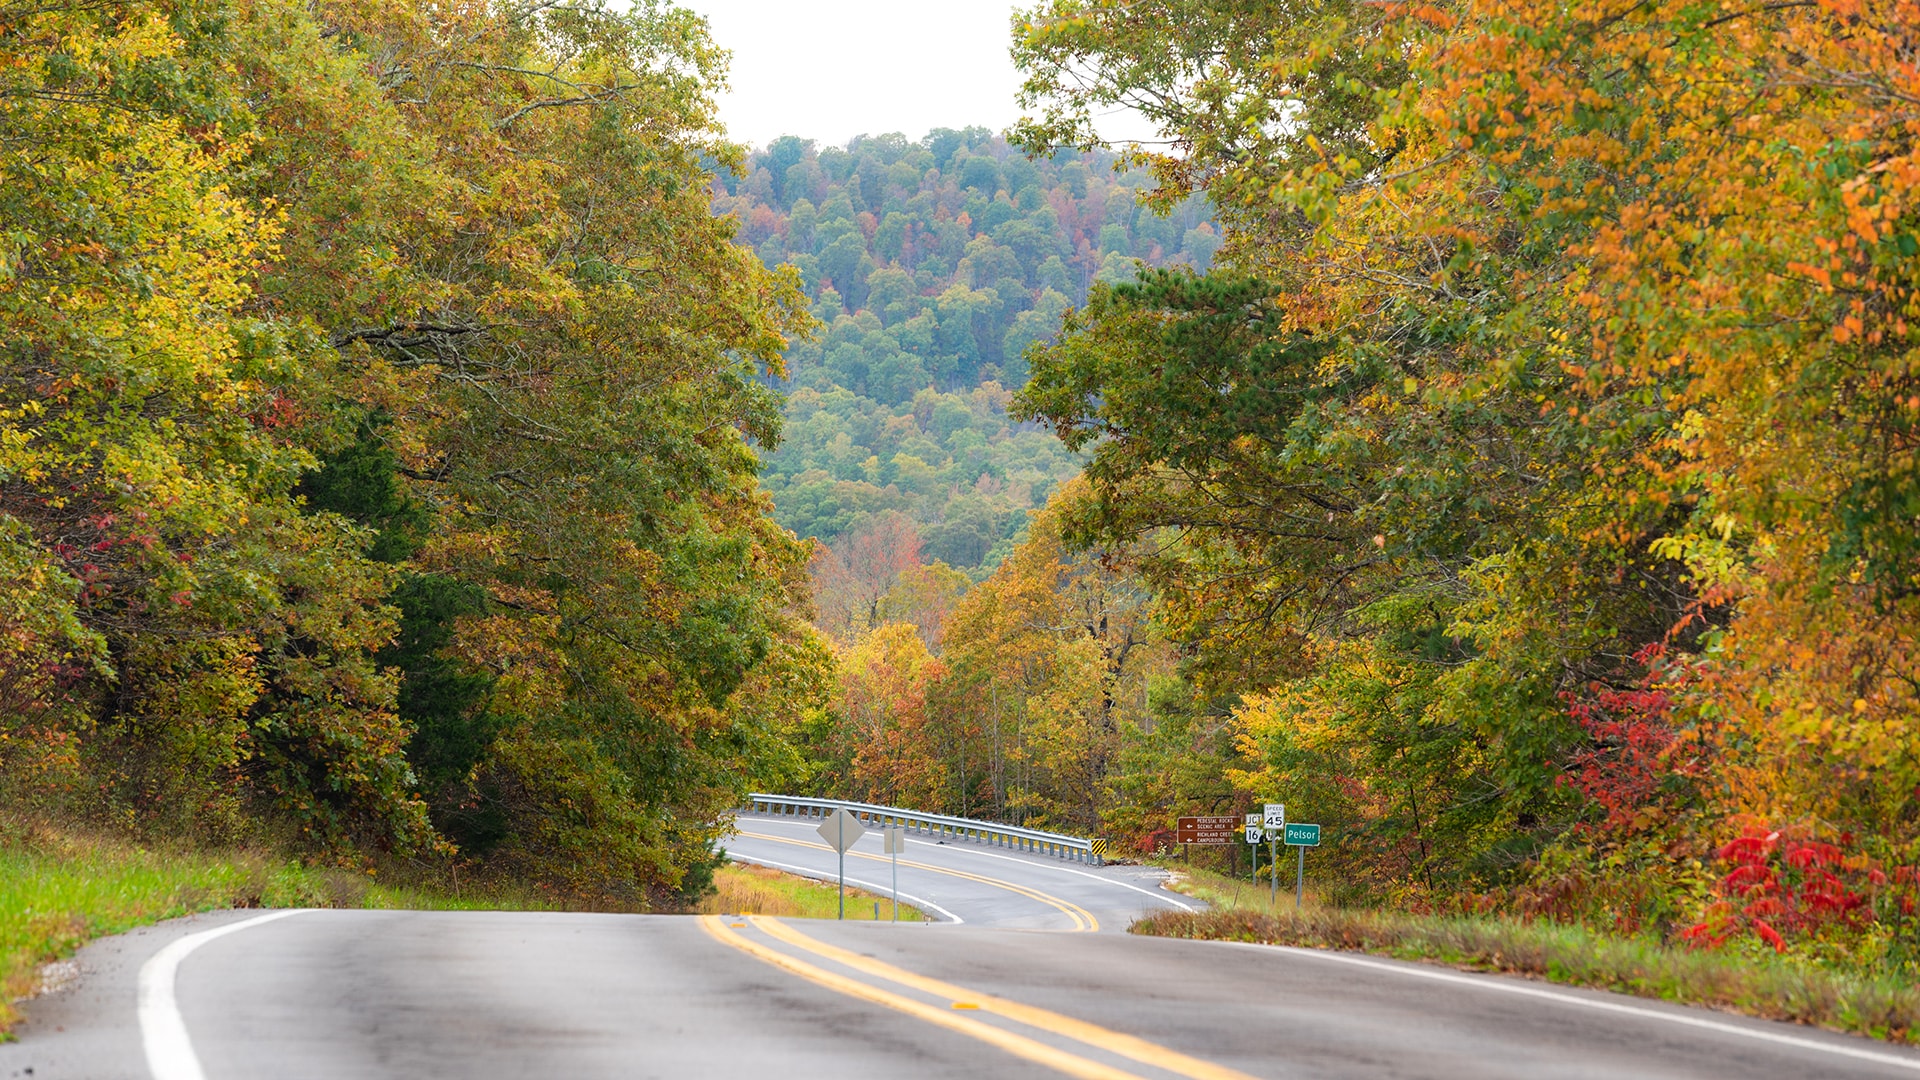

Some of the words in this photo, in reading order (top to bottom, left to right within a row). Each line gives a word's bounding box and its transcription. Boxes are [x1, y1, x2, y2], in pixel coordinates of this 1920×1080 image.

[1247, 815, 1261, 824] JCT
[1266, 816, 1283, 826] 45
[1248, 830, 1258, 840] 16
[1288, 830, 1316, 839] Pelsor
